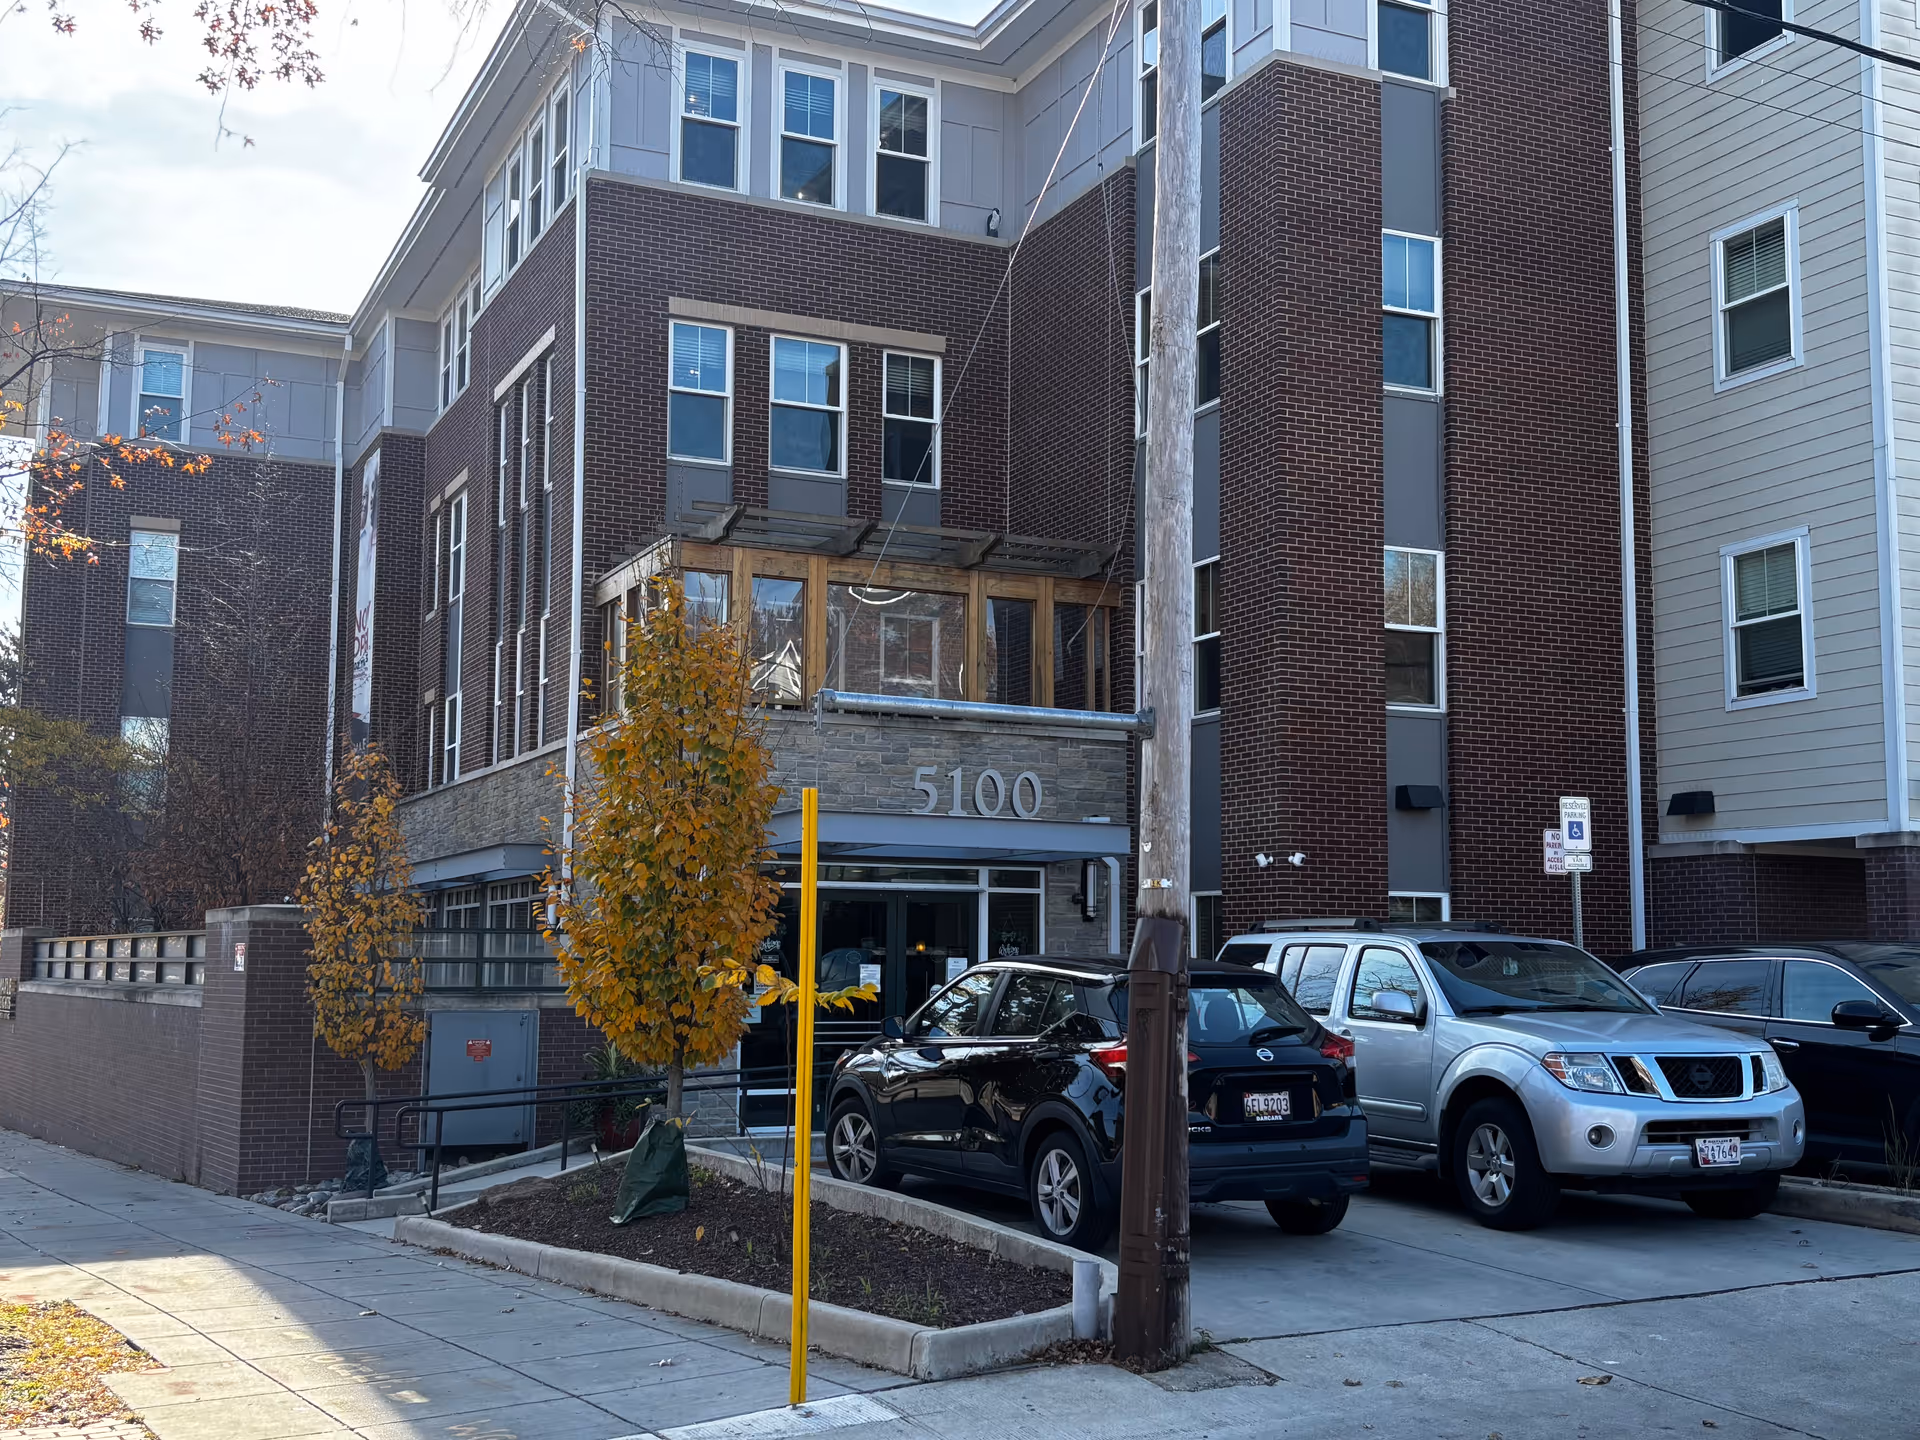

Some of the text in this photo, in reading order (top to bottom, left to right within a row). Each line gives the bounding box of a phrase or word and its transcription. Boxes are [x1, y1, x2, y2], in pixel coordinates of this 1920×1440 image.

[911, 765, 1042, 818] 5100
[1562, 802, 1587, 810] RESERVED
[1563, 811, 1586, 819] PARKING
[1551, 832, 1561, 841] NO
